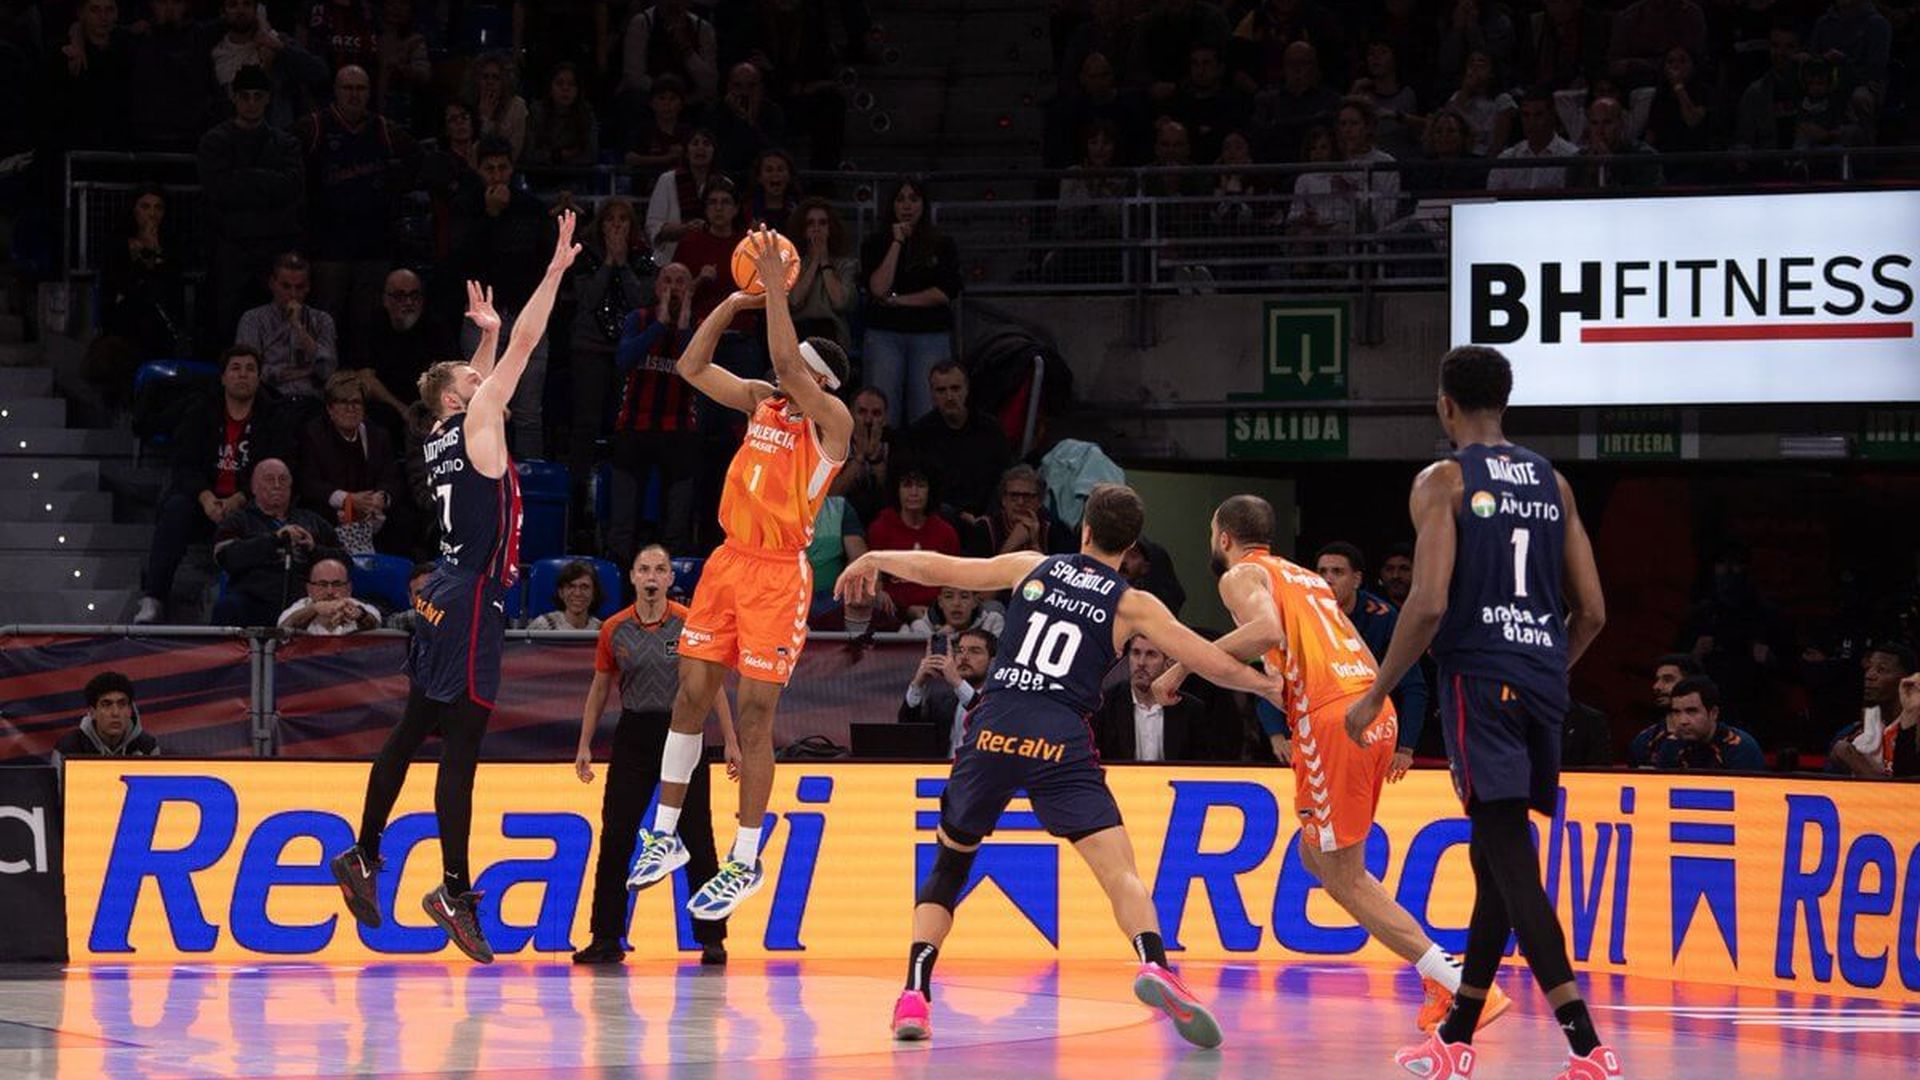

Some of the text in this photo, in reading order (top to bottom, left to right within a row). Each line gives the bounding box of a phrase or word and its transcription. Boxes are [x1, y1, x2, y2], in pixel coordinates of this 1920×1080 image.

[1233, 411, 1341, 441] SALIDA
[1603, 432, 1675, 453] IRTEERA
[748, 463, 762, 492] 1
[1049, 560, 1117, 596] SPAGNOLO
[1510, 527, 1531, 598] 1
[1044, 592, 1107, 624] AMUTIO
[1482, 602, 1534, 624] araba
[1014, 610, 1083, 679] 10
[976, 729, 1066, 763] Recalvi
[1151, 780, 1636, 965] Reclvi
